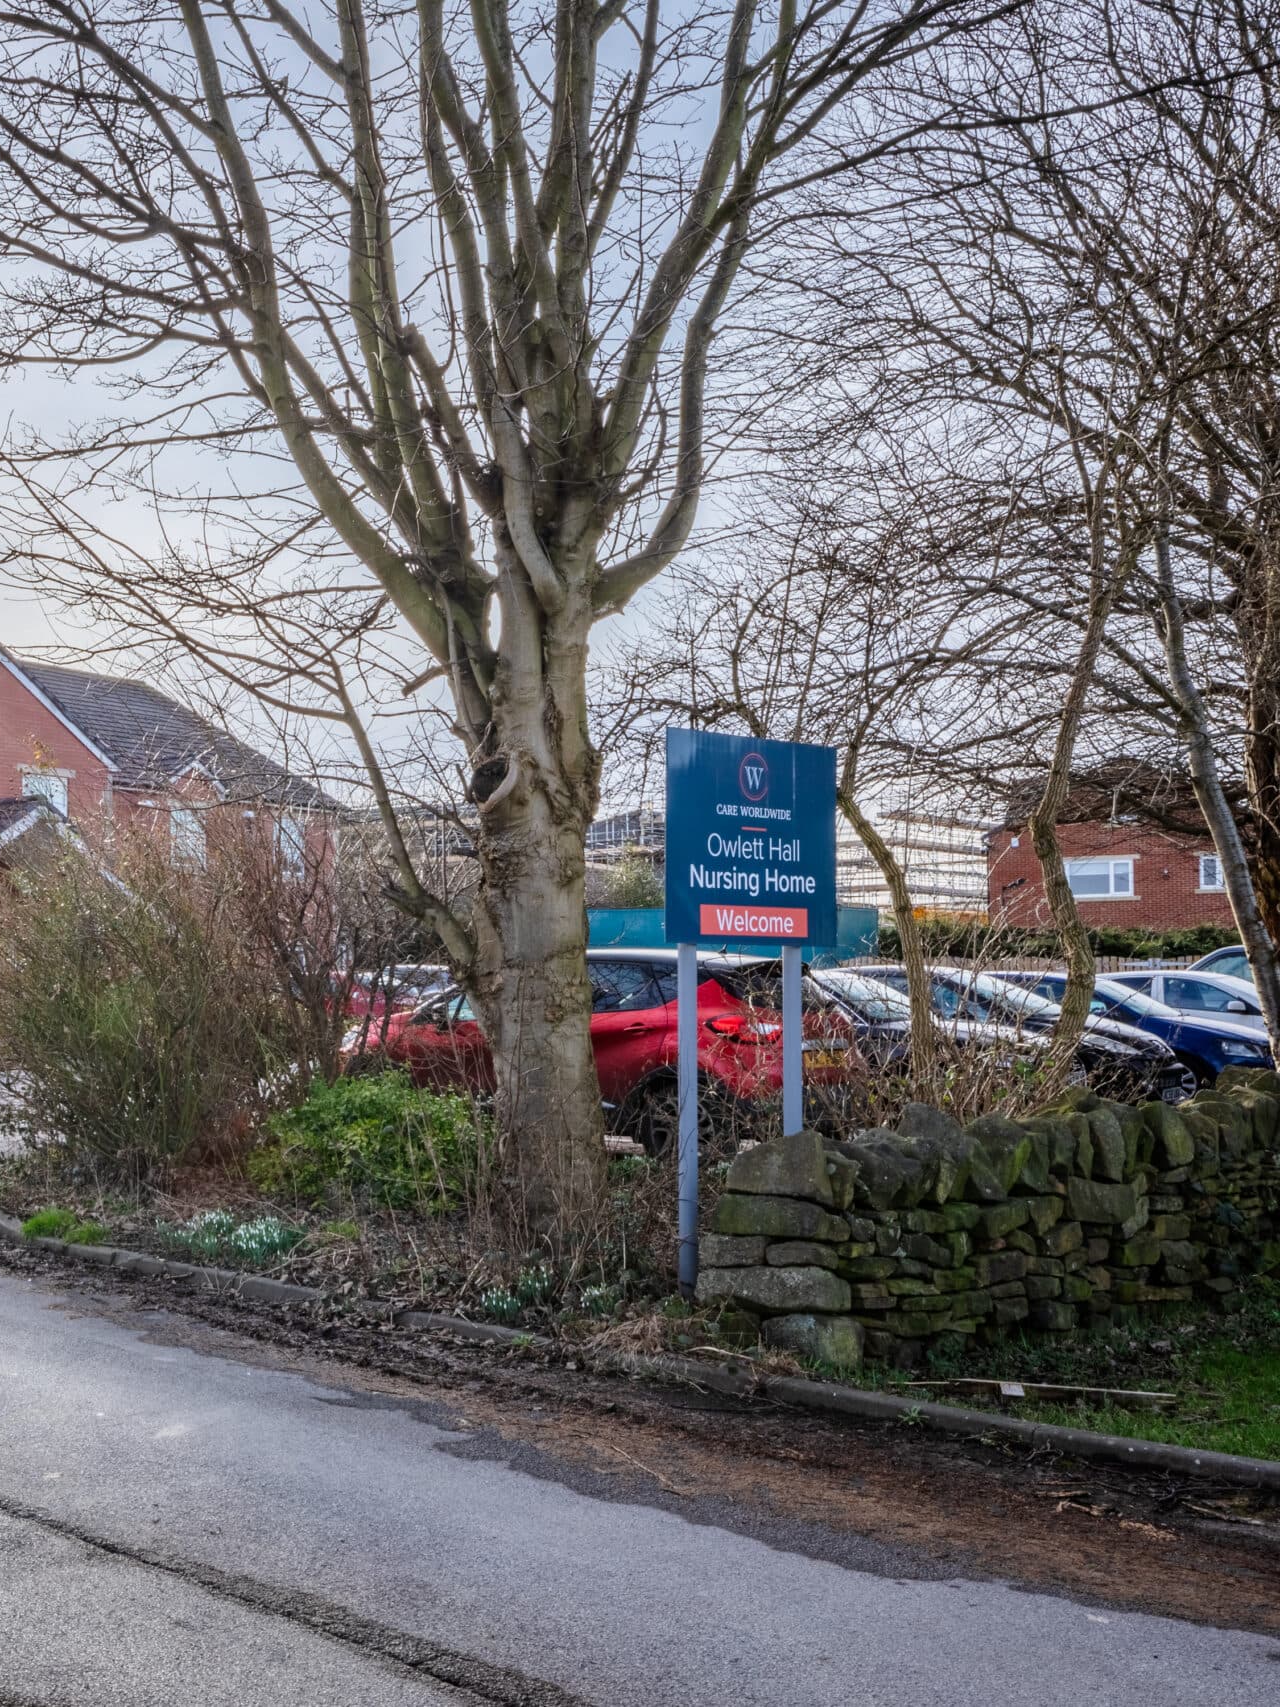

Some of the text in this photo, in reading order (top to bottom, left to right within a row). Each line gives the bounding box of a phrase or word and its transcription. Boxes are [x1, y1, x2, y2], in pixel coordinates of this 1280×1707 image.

[716, 803, 791, 821] CARE WORLDWIDE
[707, 832, 800, 862] Owlett Hall
[689, 863, 816, 897] Nursing Home
[716, 908, 794, 934] Welcome
